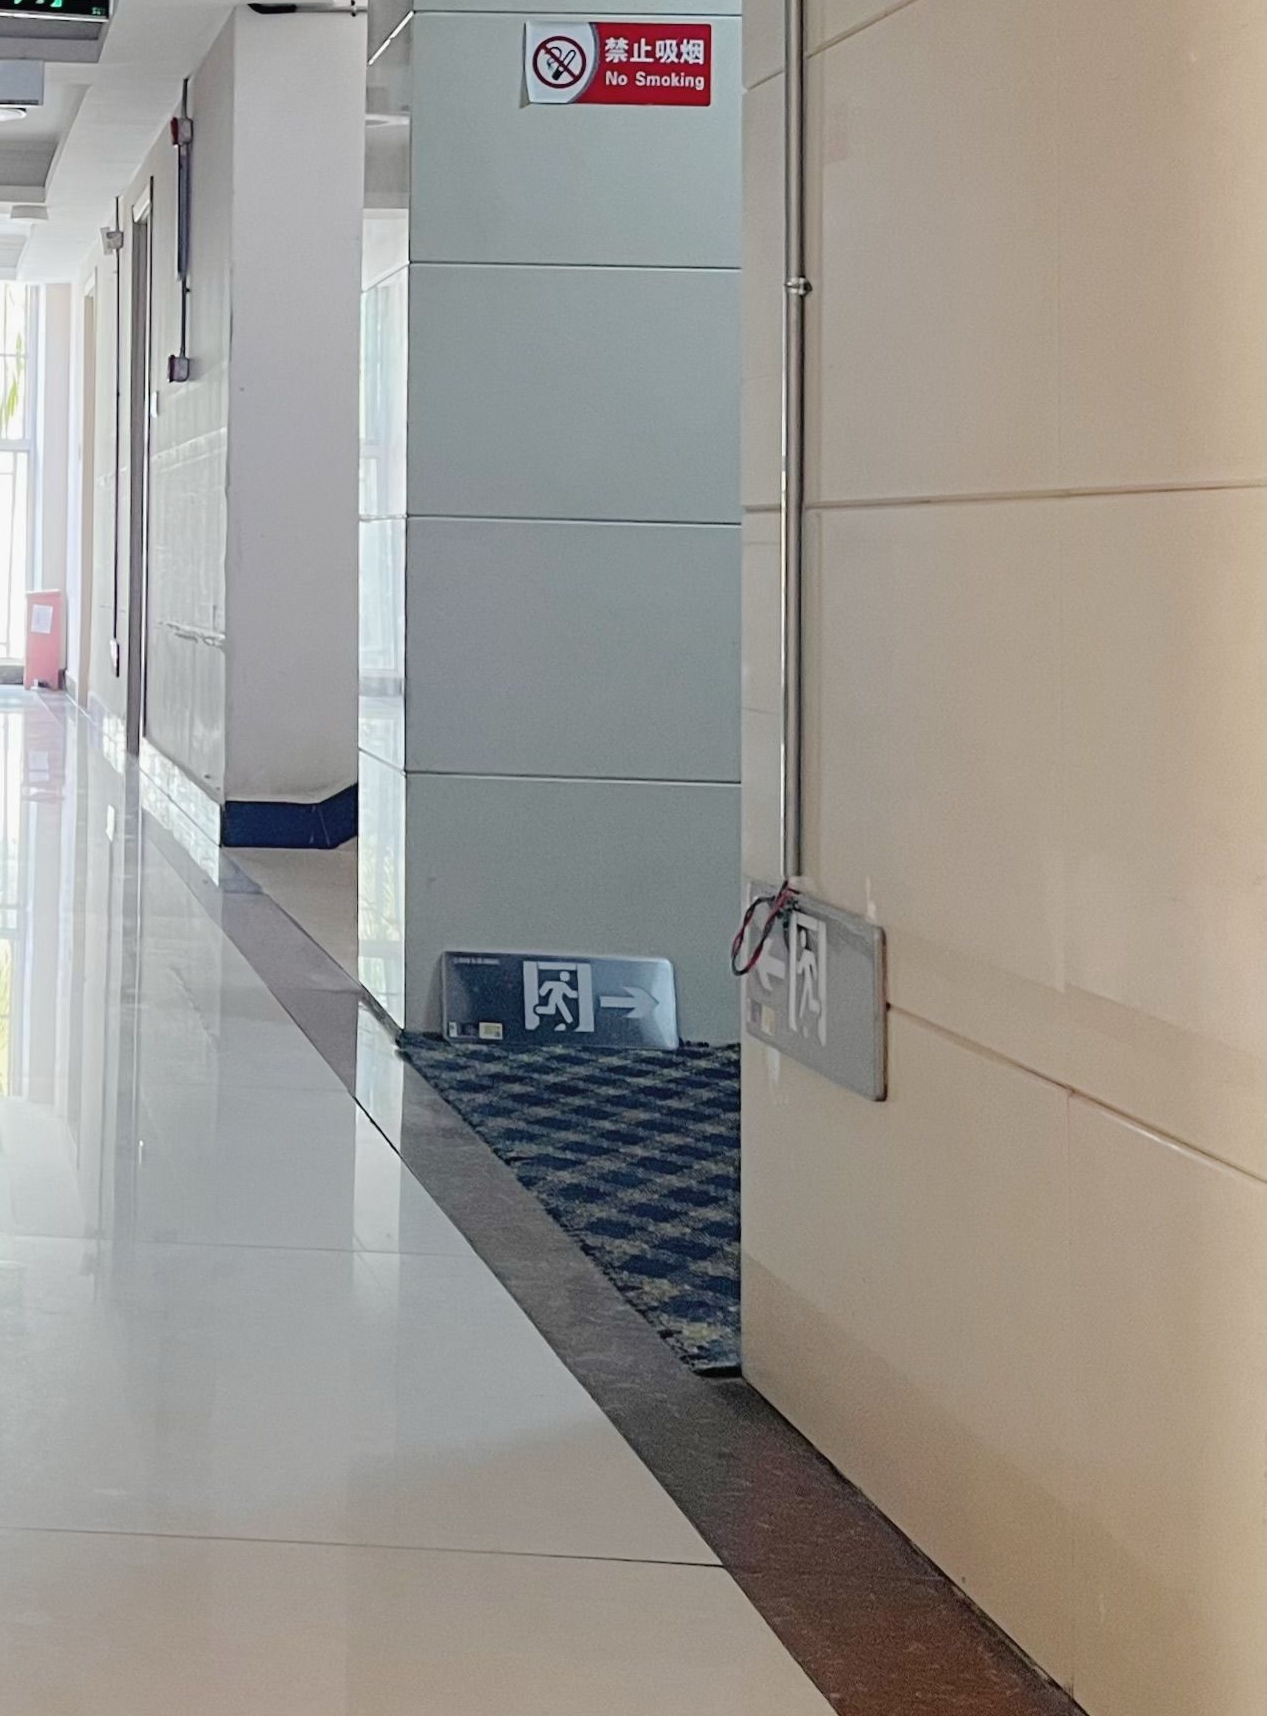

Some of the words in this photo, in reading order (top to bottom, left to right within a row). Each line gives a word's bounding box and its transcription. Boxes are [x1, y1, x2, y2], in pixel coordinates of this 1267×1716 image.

[604, 36, 705, 65] 禁止吸烟
[605, 70, 628, 86] No
[635, 70, 705, 91] Smoking
